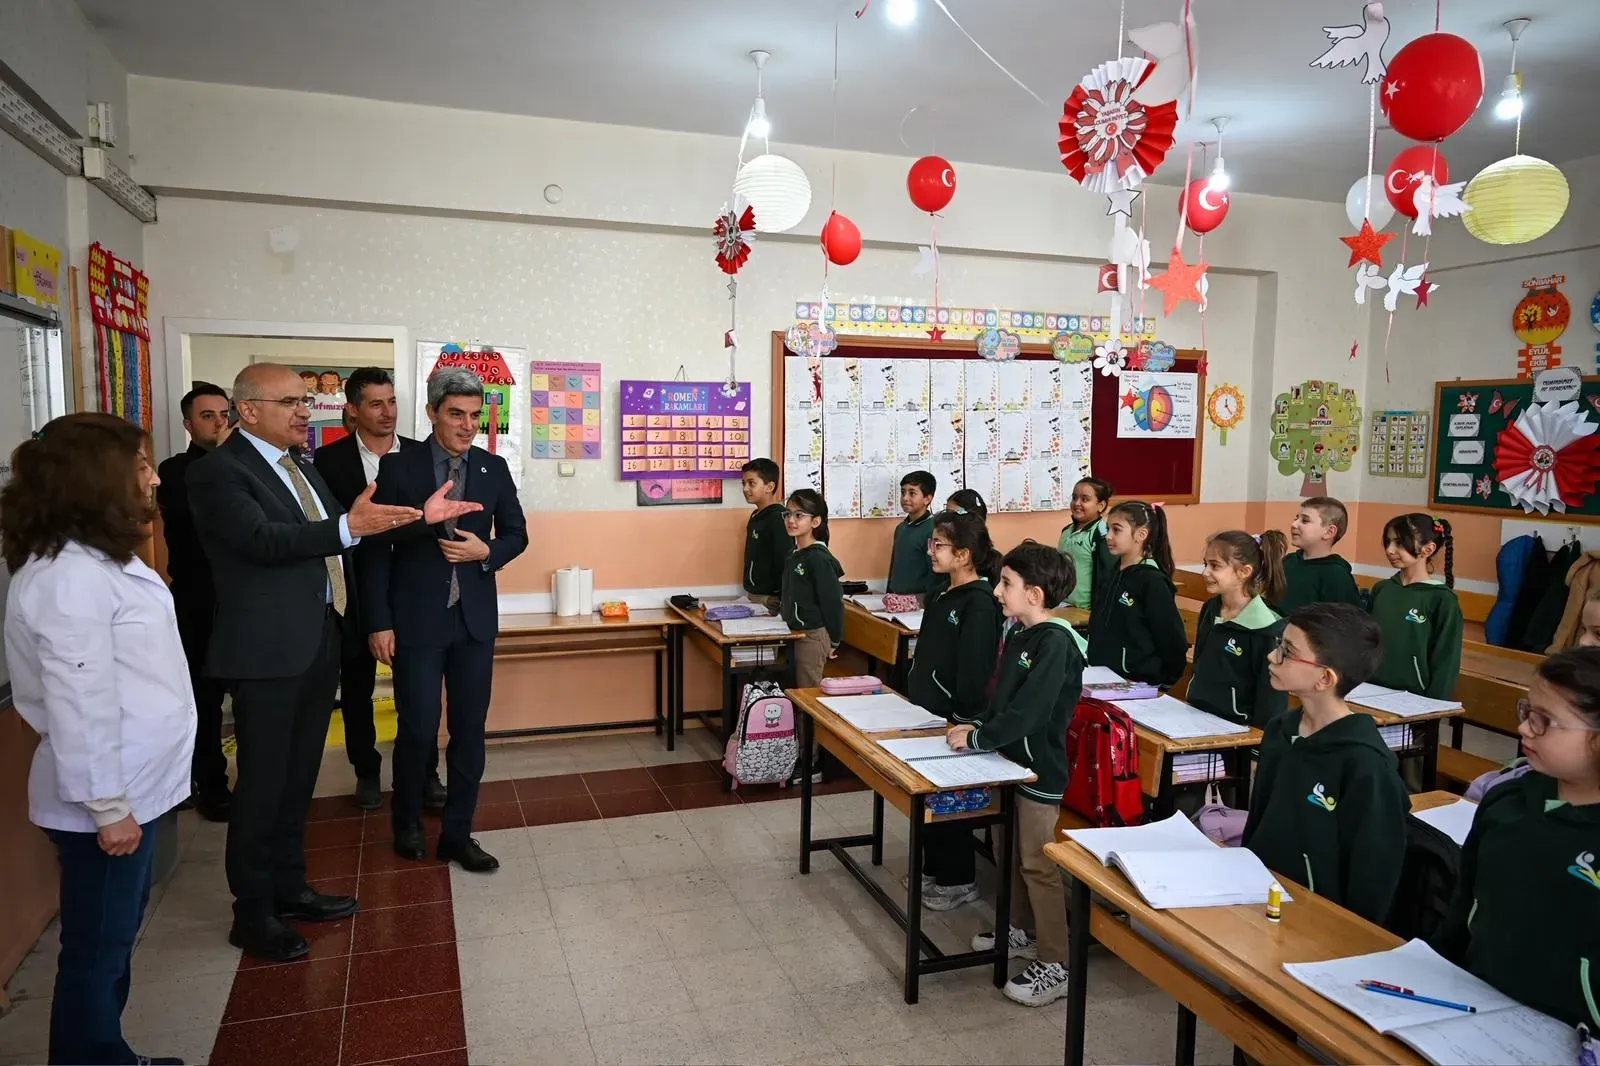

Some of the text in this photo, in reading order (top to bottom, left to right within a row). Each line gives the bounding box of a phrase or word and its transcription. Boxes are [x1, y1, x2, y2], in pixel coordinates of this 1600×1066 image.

[442, 352, 448, 360] 0
[464, 352, 470, 360] 2
[470, 363, 477, 372] 9
[668, 391, 698, 402] ROMEN
[664, 402, 706, 411] RAKAMLARI
[631, 416, 635, 426] 1
[654, 416, 660, 426] 2
[680, 416, 686, 426] 3
[732, 418, 738, 427] 5
[630, 431, 742, 441] 6 7 8 9 10
[628, 447, 636, 455] 11
[653, 446, 664, 455] 12
[678, 446, 688, 455] 13
[628, 460, 742, 470] 16 17 18 19 20
